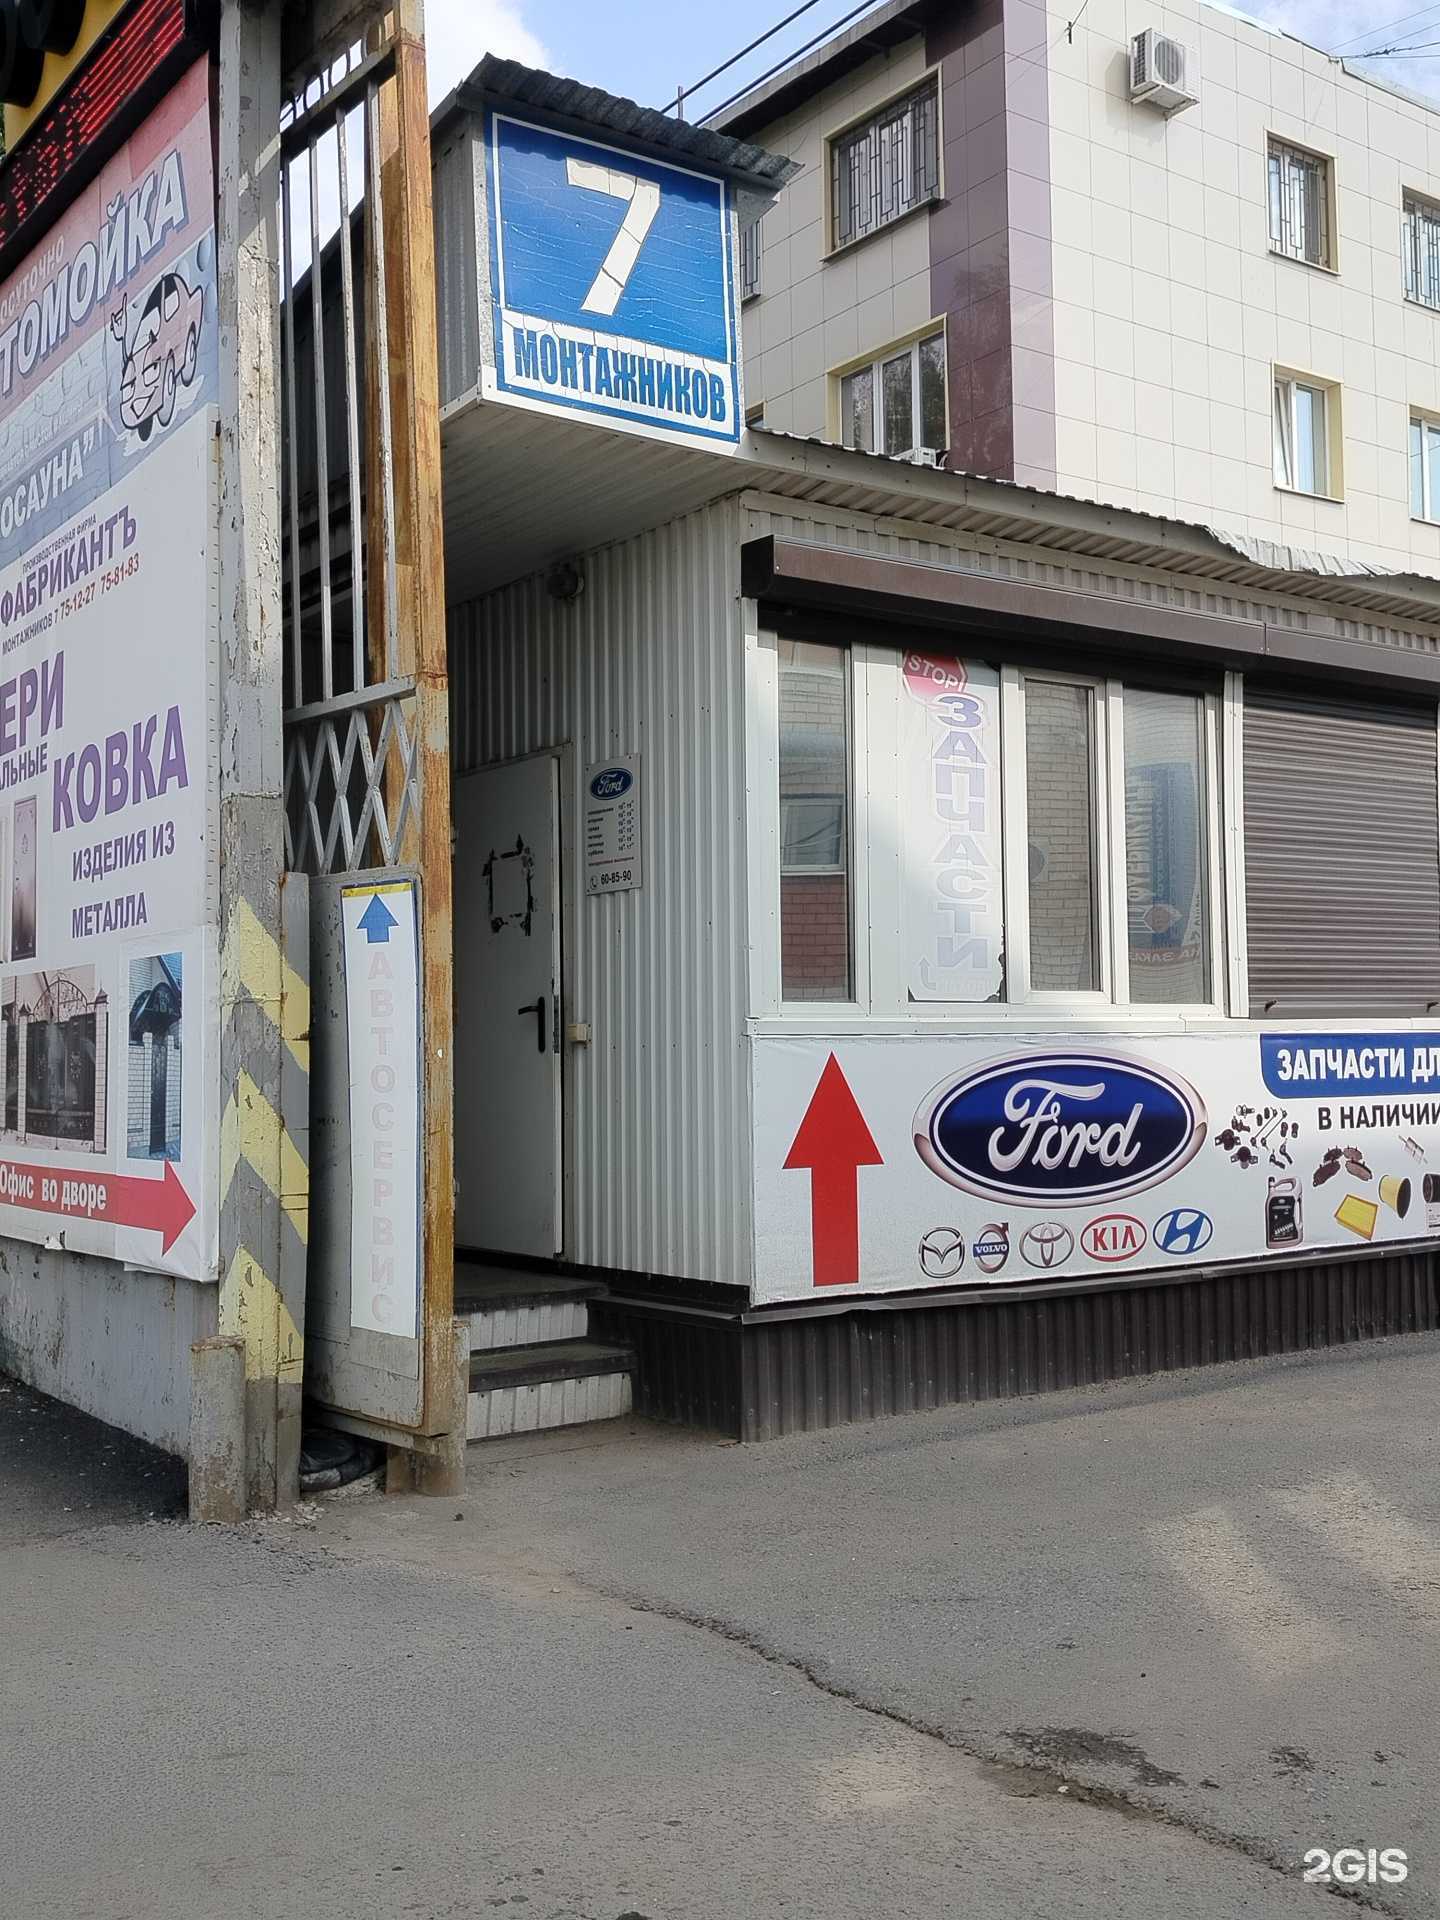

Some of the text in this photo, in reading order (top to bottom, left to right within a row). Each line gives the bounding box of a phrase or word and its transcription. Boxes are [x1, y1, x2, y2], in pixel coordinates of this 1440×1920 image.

[565, 156, 661, 317] 7
[0, 149, 189, 396] ТОМОЙКА
[513, 327, 726, 423] МОНТАЖНИКОВ
[0, 505, 137, 627] ФАБРИКАНТЪ
[2, 612, 53, 655] МОНТАЖНИКОВ
[60, 582, 96, 620] 75-12-27
[100, 552, 140, 595] 75-81-83
[903, 654, 959, 689] STOP
[0, 742, 48, 791] ЛЬНЫЕ
[52, 704, 189, 833] КОВКА
[596, 772, 626, 796] Ford
[72, 820, 176, 883] ИЗДЕЛИЯ ИЗ
[932, 694, 990, 970] ЗАПЧАСТИ
[600, 869, 633, 886] 60-85-90
[72, 892, 148, 939] МЕТАЛЛА
[1276, 1047, 1406, 1081] ЗАПЧАСТИ
[368, 950, 396, 1325] АВТОСЕРВИС
[987, 1078, 1144, 1172] Ford
[1318, 1106, 1333, 1131] В
[0, 1163, 107, 1217] Офис во дворе
[974, 1243, 1008, 1254] VOLVO
[1092, 1225, 1138, 1252] KIA
